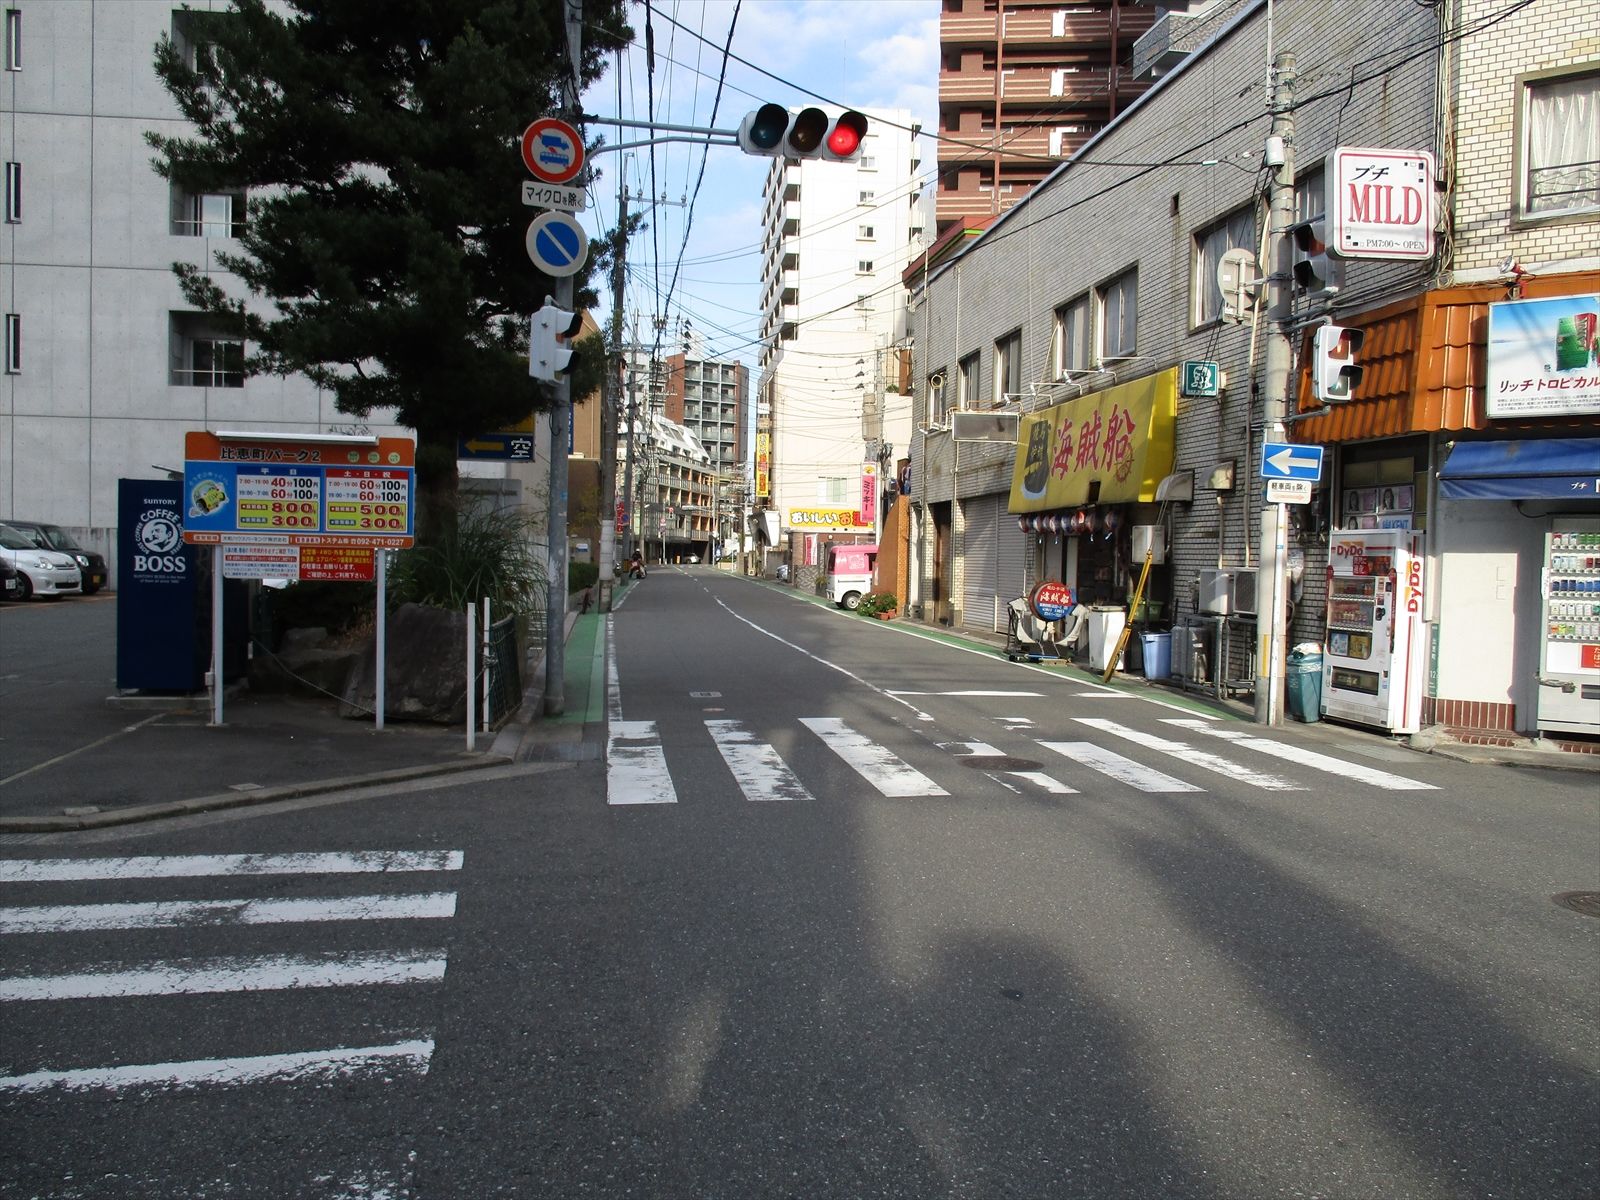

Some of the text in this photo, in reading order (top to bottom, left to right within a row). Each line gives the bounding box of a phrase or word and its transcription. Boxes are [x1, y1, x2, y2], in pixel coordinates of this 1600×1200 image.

[1350, 165, 1390, 182] プチ
[526, 186, 582, 207] マイクロを除く
[1348, 183, 1422, 225] MILD
[1403, 241, 1425, 249] OPEN
[511, 438, 532, 458] 空
[1051, 404, 1136, 480] 海賊船
[220, 447, 321, 462] 比恵町パーク2
[1271, 482, 1307, 491] 軽車両を除く
[1571, 482, 1587, 490] プチ
[143, 498, 177, 506] SUNTORY
[140, 508, 180, 522] COFFEE
[1337, 545, 1363, 558] DyDo
[134, 555, 186, 573] BOSS
[1407, 561, 1422, 612] DyDo
